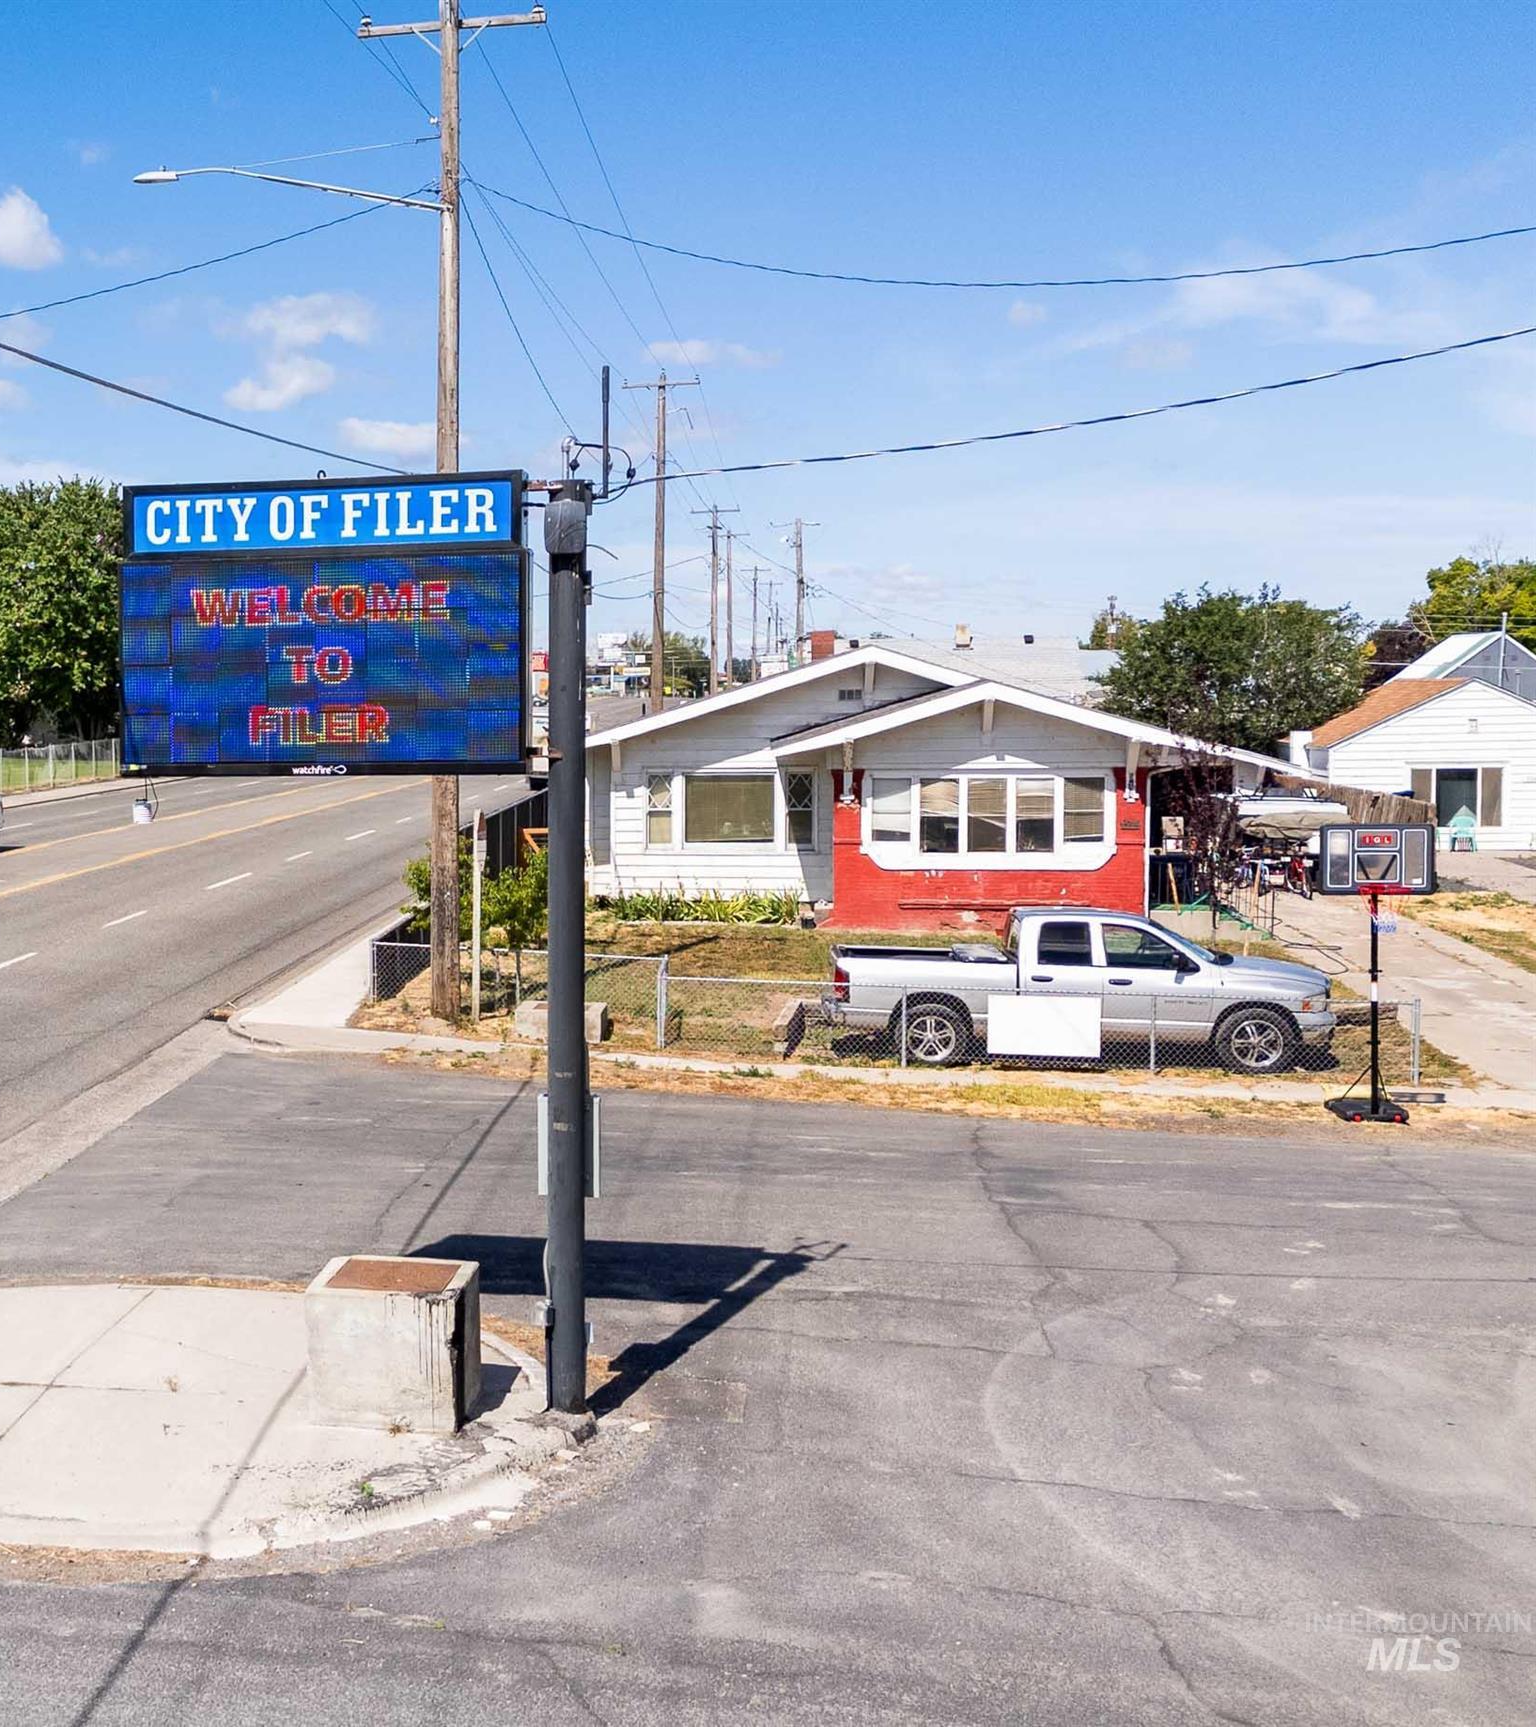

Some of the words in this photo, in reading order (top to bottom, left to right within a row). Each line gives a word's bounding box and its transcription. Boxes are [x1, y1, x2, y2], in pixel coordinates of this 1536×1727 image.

[146, 497, 256, 545] CITY
[269, 494, 328, 542] OF
[340, 488, 497, 539] FILER
[191, 580, 450, 626] WELCOME
[283, 645, 352, 684] TO
[248, 703, 389, 745] FILER
[292, 764, 332, 775] watchfire
